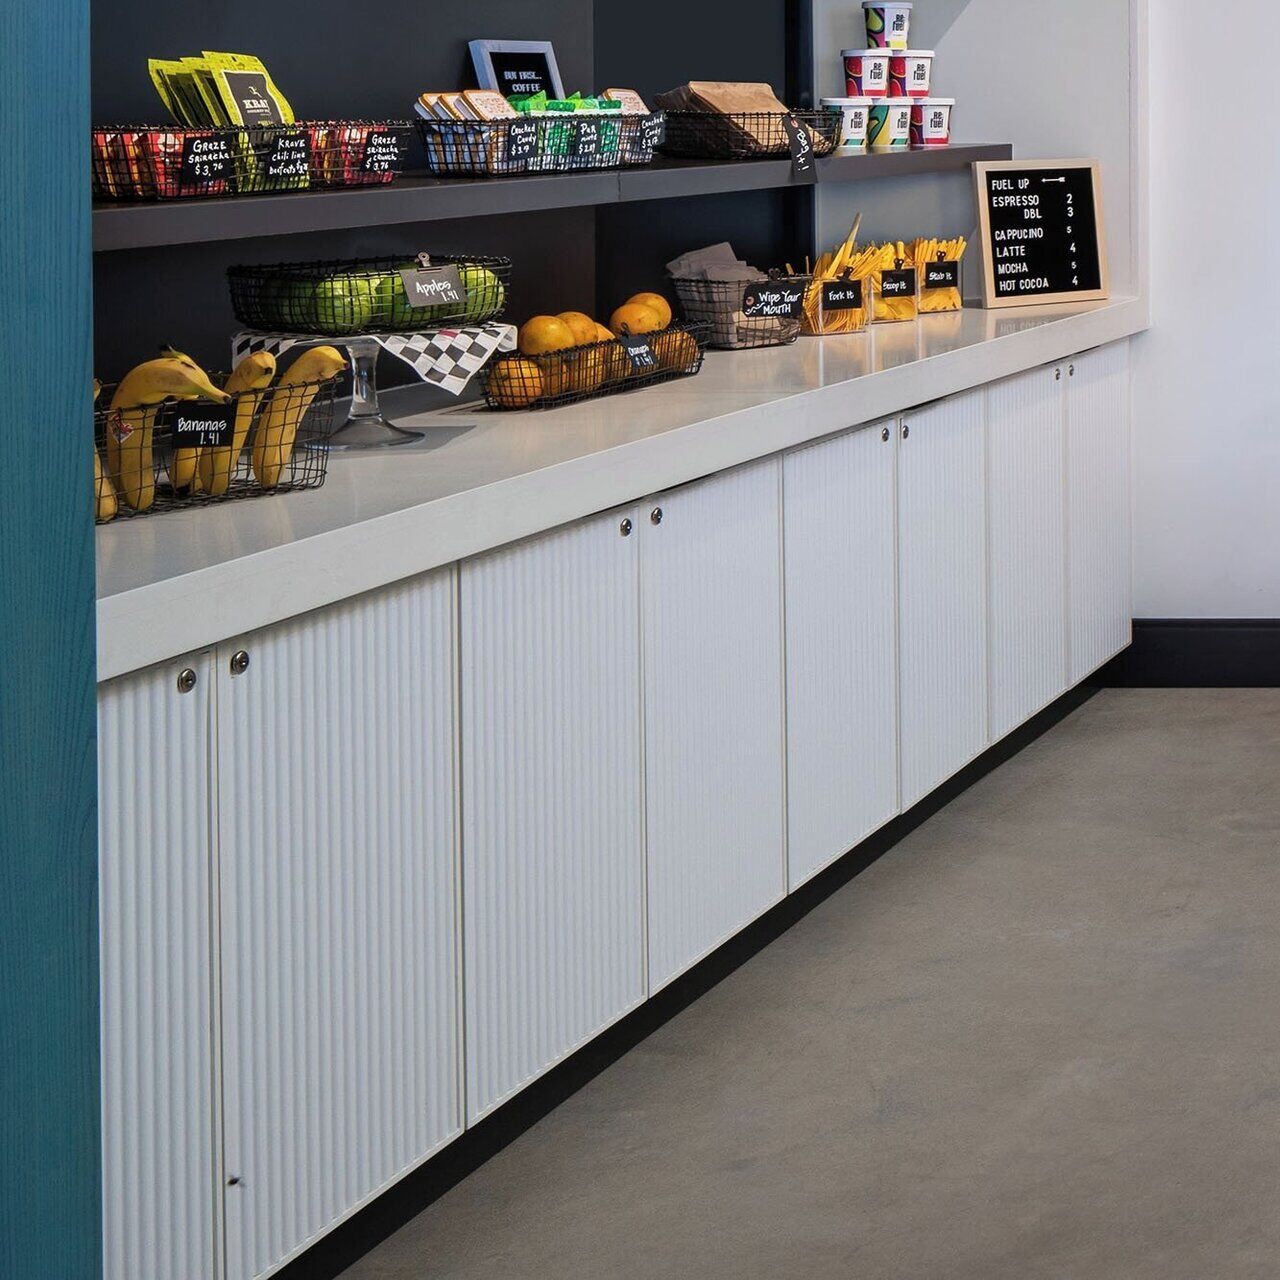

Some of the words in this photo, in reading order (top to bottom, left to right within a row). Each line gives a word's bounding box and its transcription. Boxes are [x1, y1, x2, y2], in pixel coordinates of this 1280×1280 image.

[504, 71, 517, 80] BUT
[870, 70, 883, 80] fuel
[913, 70, 926, 80] fuel
[511, 83, 541, 92] COFFEE
[850, 119, 863, 128] fuel
[930, 119, 944, 128] fuel
[992, 179, 1014, 191] FUEL
[1018, 178, 1030, 189] UP
[992, 194, 1040, 208] ESPRESSO
[1066, 193, 1073, 204] 2
[1023, 208, 1042, 219] DBL
[1067, 206, 1074, 217] 3
[1066, 225, 1072, 234] 5
[996, 245, 1026, 258] LATTE
[1069, 242, 1076, 253] 4
[998, 262, 1029, 275] MOCHA
[1071, 261, 1077, 270] 5
[415, 279, 451, 297] Apples
[883, 281, 900, 293] Scoop
[999, 280, 1016, 291] HOT
[1019, 277, 1049, 290] COCOA
[1071, 275, 1078, 286] 4
[440, 289, 460, 302] 1.41
[759, 290, 781, 306] Wipe
[781, 289, 802, 303] Your
[828, 290, 845, 301] Fork
[177, 417, 227, 433] Bananas
[200, 431, 220, 445] 1.41
